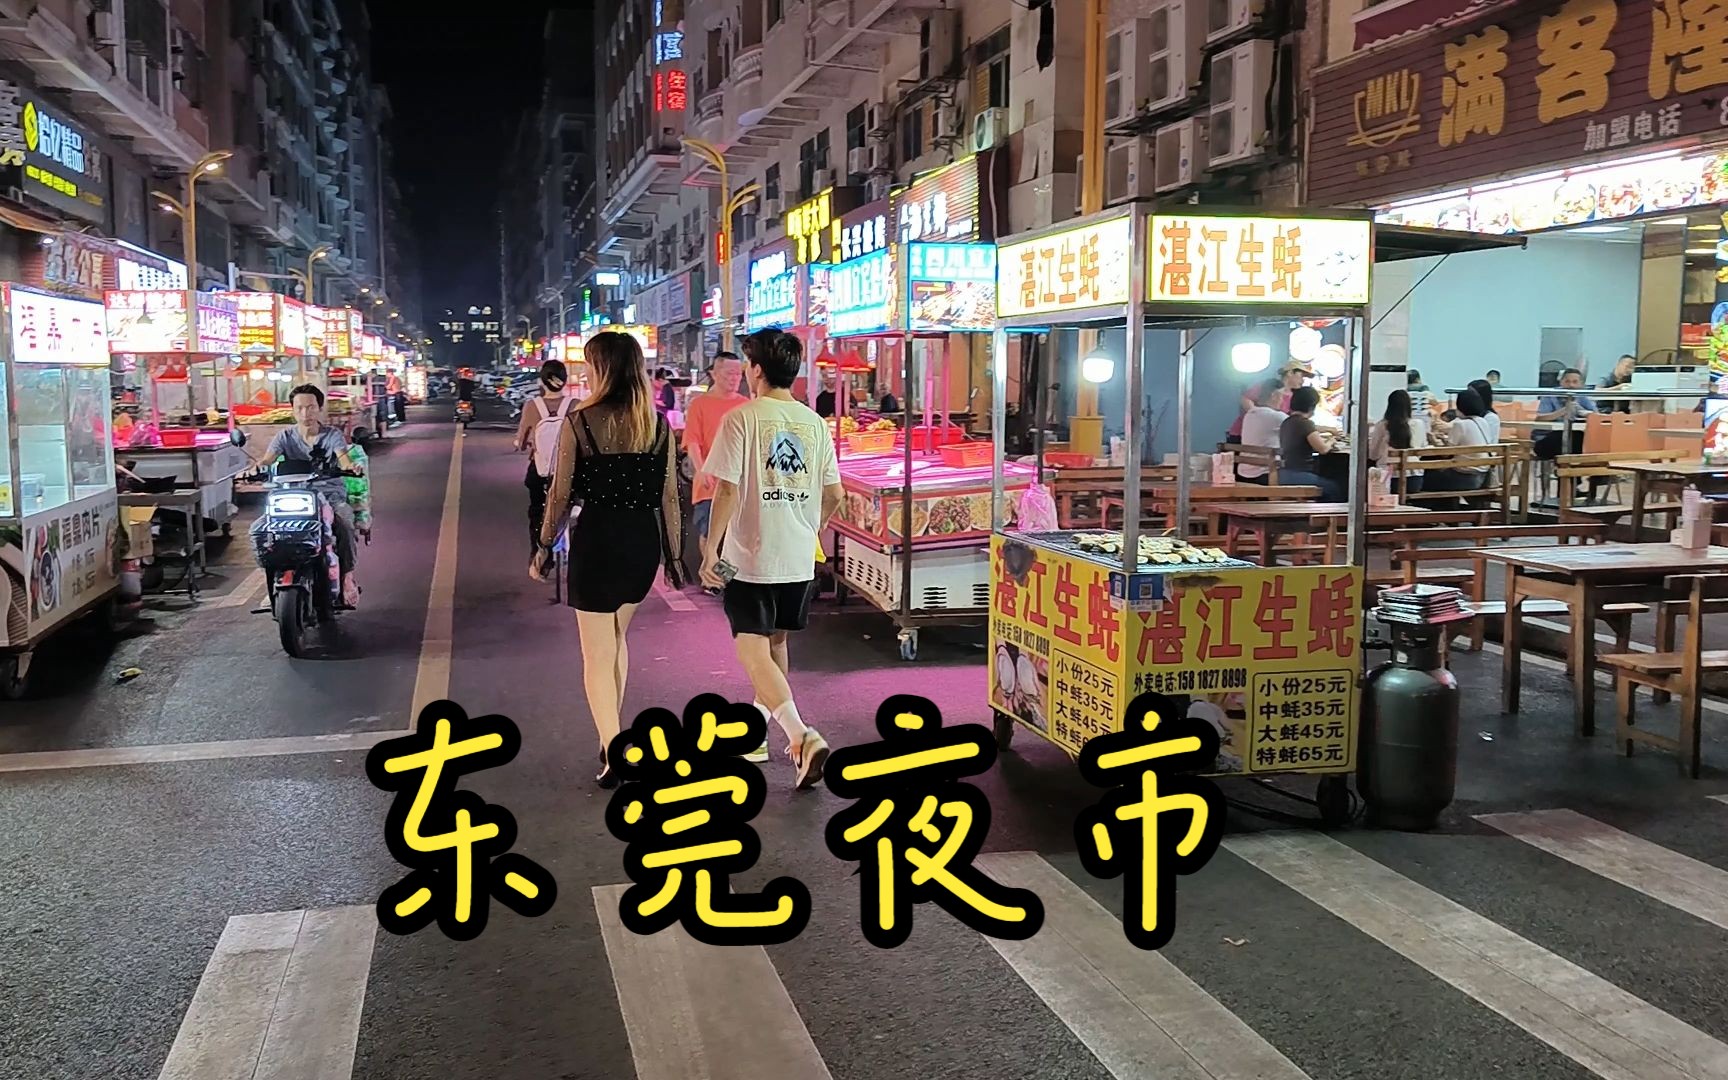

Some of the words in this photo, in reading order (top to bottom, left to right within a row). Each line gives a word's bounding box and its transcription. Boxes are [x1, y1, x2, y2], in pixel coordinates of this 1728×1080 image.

[1583, 103, 1682, 152] 加盟电话
[926, 246, 995, 267] 四川宜
[1018, 233, 1100, 309] 湛江生蚝
[1160, 220, 1302, 298] 湛江生蚝
[1137, 573, 1355, 666] 湛江生蚝
[1056, 657, 1114, 698] 小份25元
[1197, 669, 1220, 690] 1827
[1222, 667, 1248, 689] 8898
[1259, 676, 1347, 697] 小份25元
[1056, 678, 1113, 721] 中蚝35元
[1259, 699, 1345, 721] 中蚝35元
[1257, 721, 1345, 743] 大蚝45元
[1256, 744, 1344, 766] 特蚝65元
